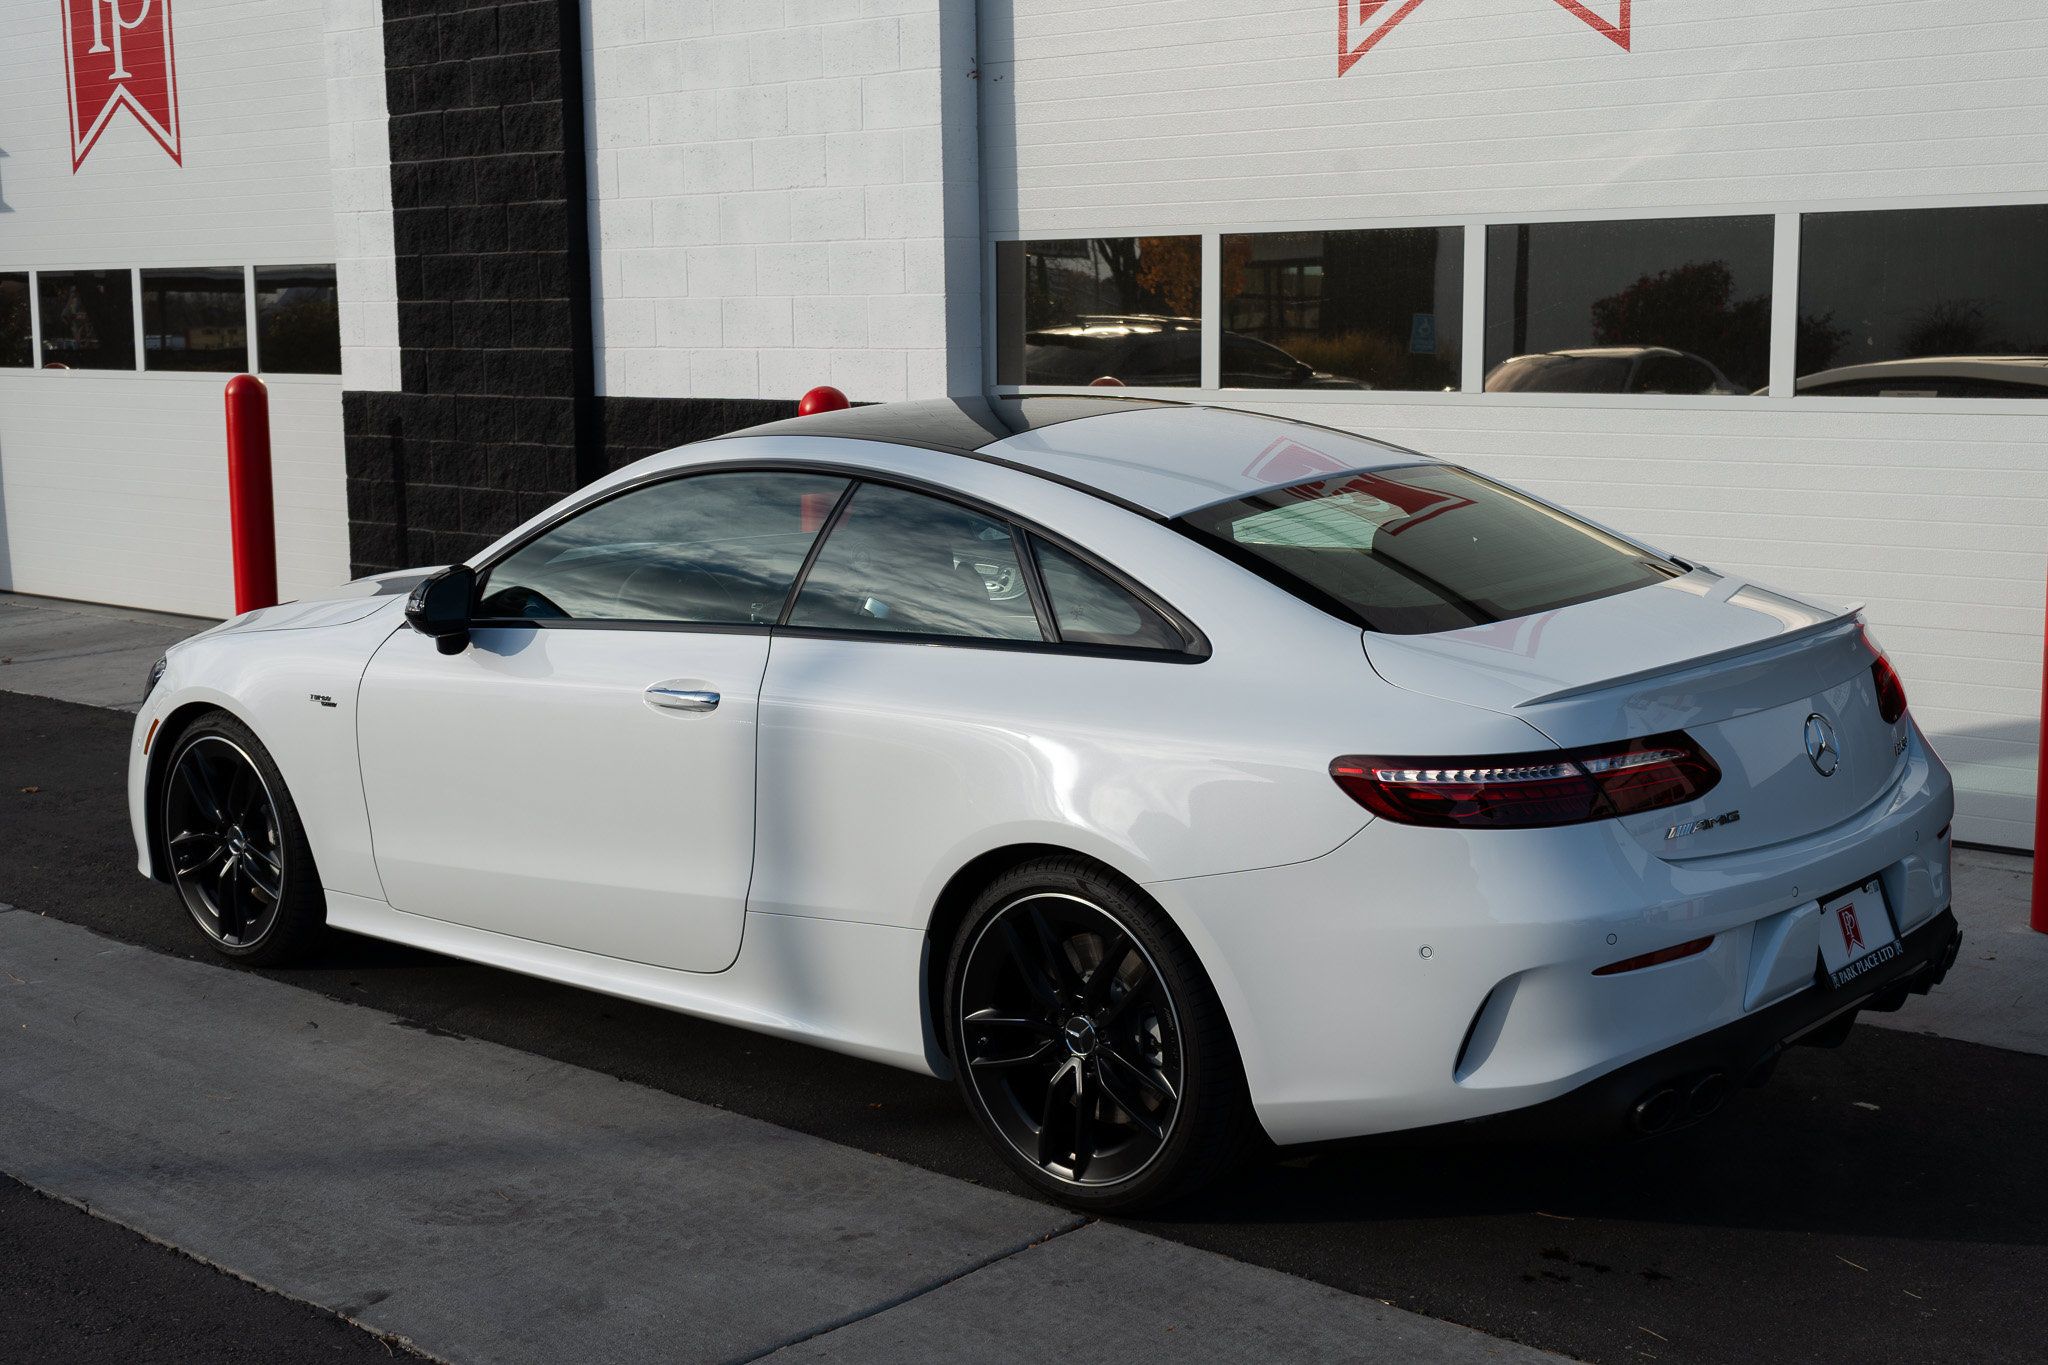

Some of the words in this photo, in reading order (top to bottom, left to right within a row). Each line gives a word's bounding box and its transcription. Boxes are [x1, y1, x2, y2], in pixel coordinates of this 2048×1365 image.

[1692, 810, 1741, 834] AMG
[1838, 965, 1859, 984] PARK
[1856, 951, 1880, 975] PLACE
[1878, 946, 1894, 963] LTD
